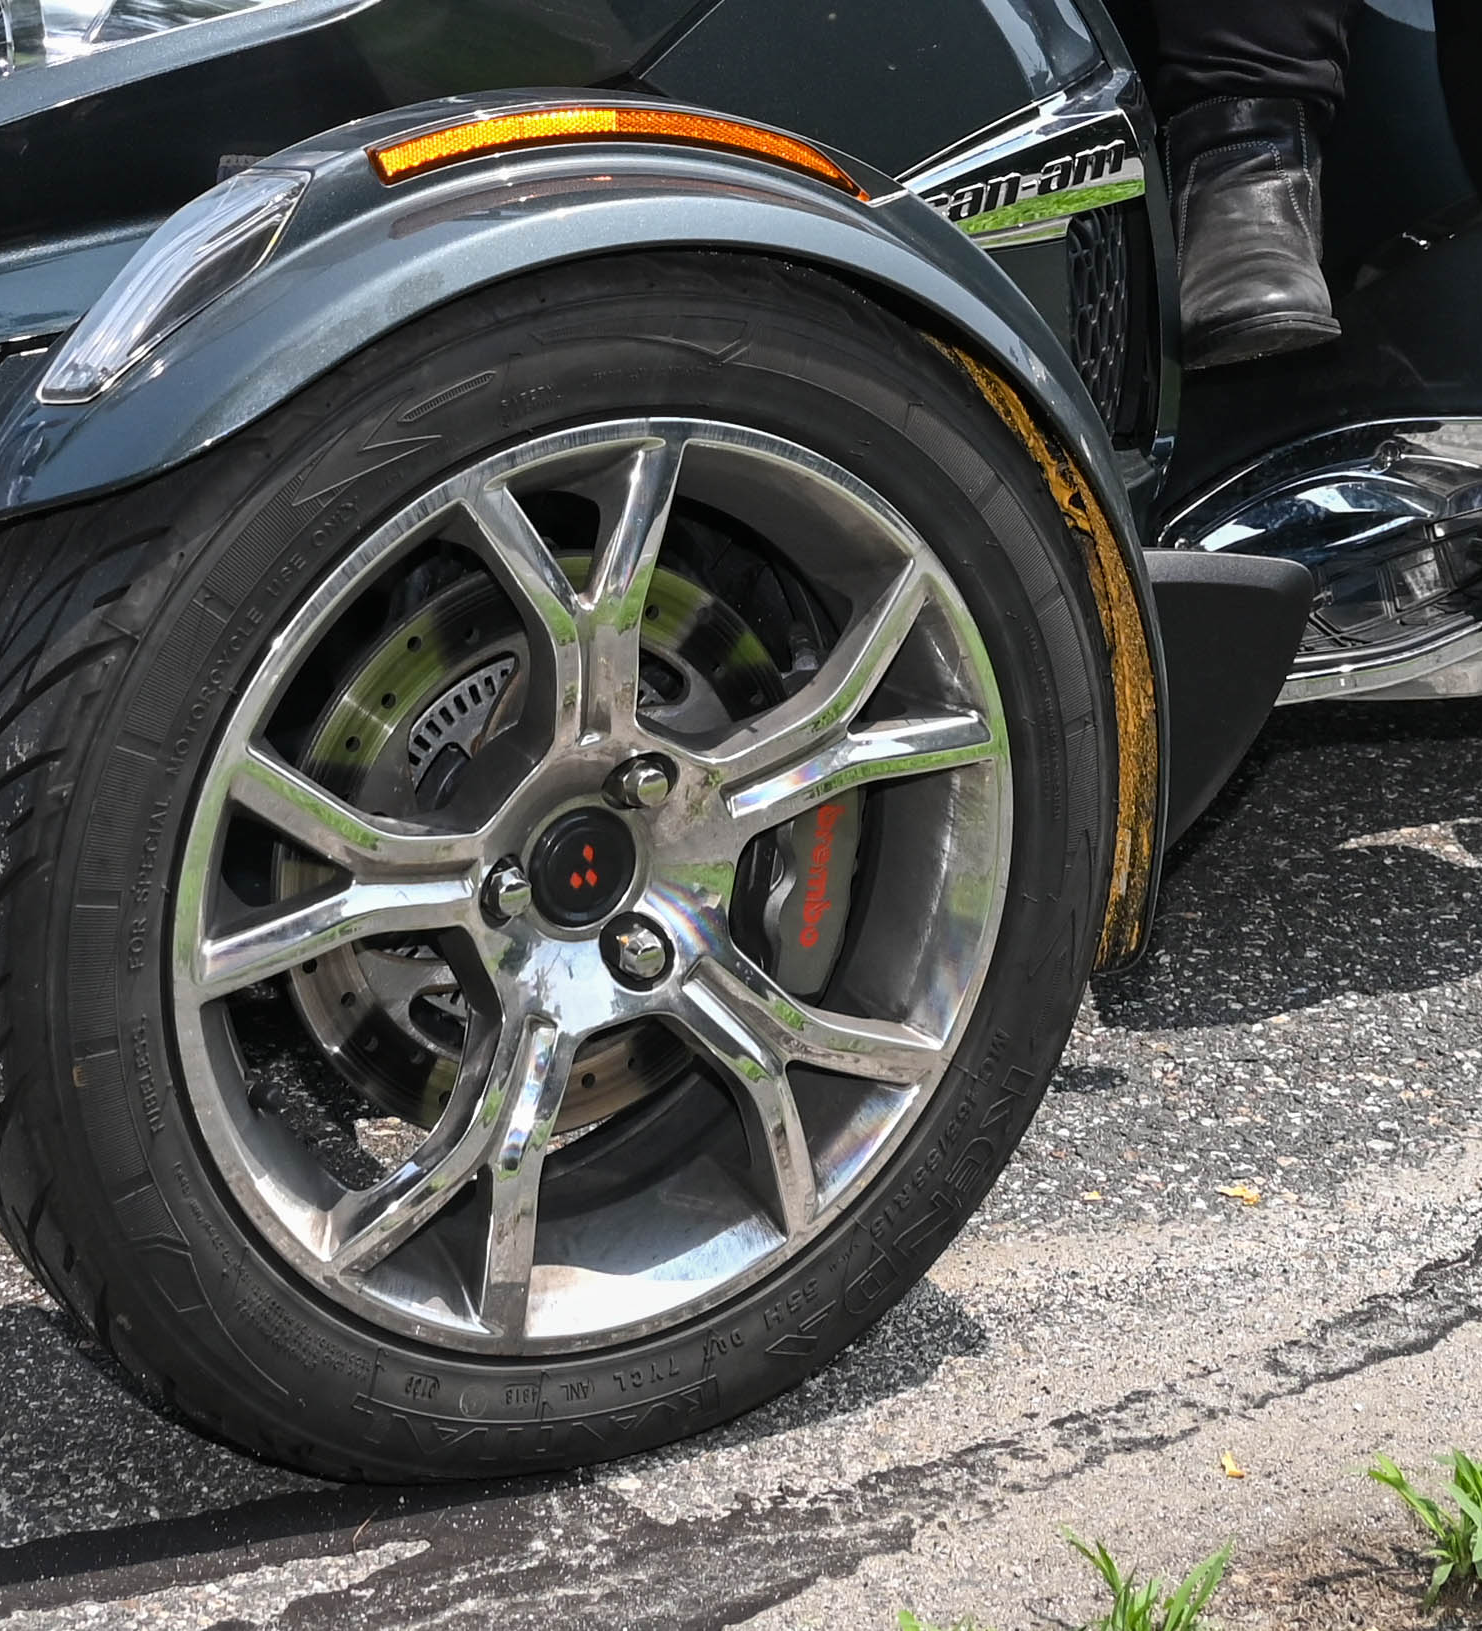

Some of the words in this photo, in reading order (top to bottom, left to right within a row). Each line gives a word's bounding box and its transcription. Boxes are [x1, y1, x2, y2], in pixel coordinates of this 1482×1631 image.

[165, 608, 265, 778] MOTORCYCLE
[266, 553, 307, 598] USE
[799, 805, 847, 948] brembo
[763, 1063, 1035, 1352] KENDA
